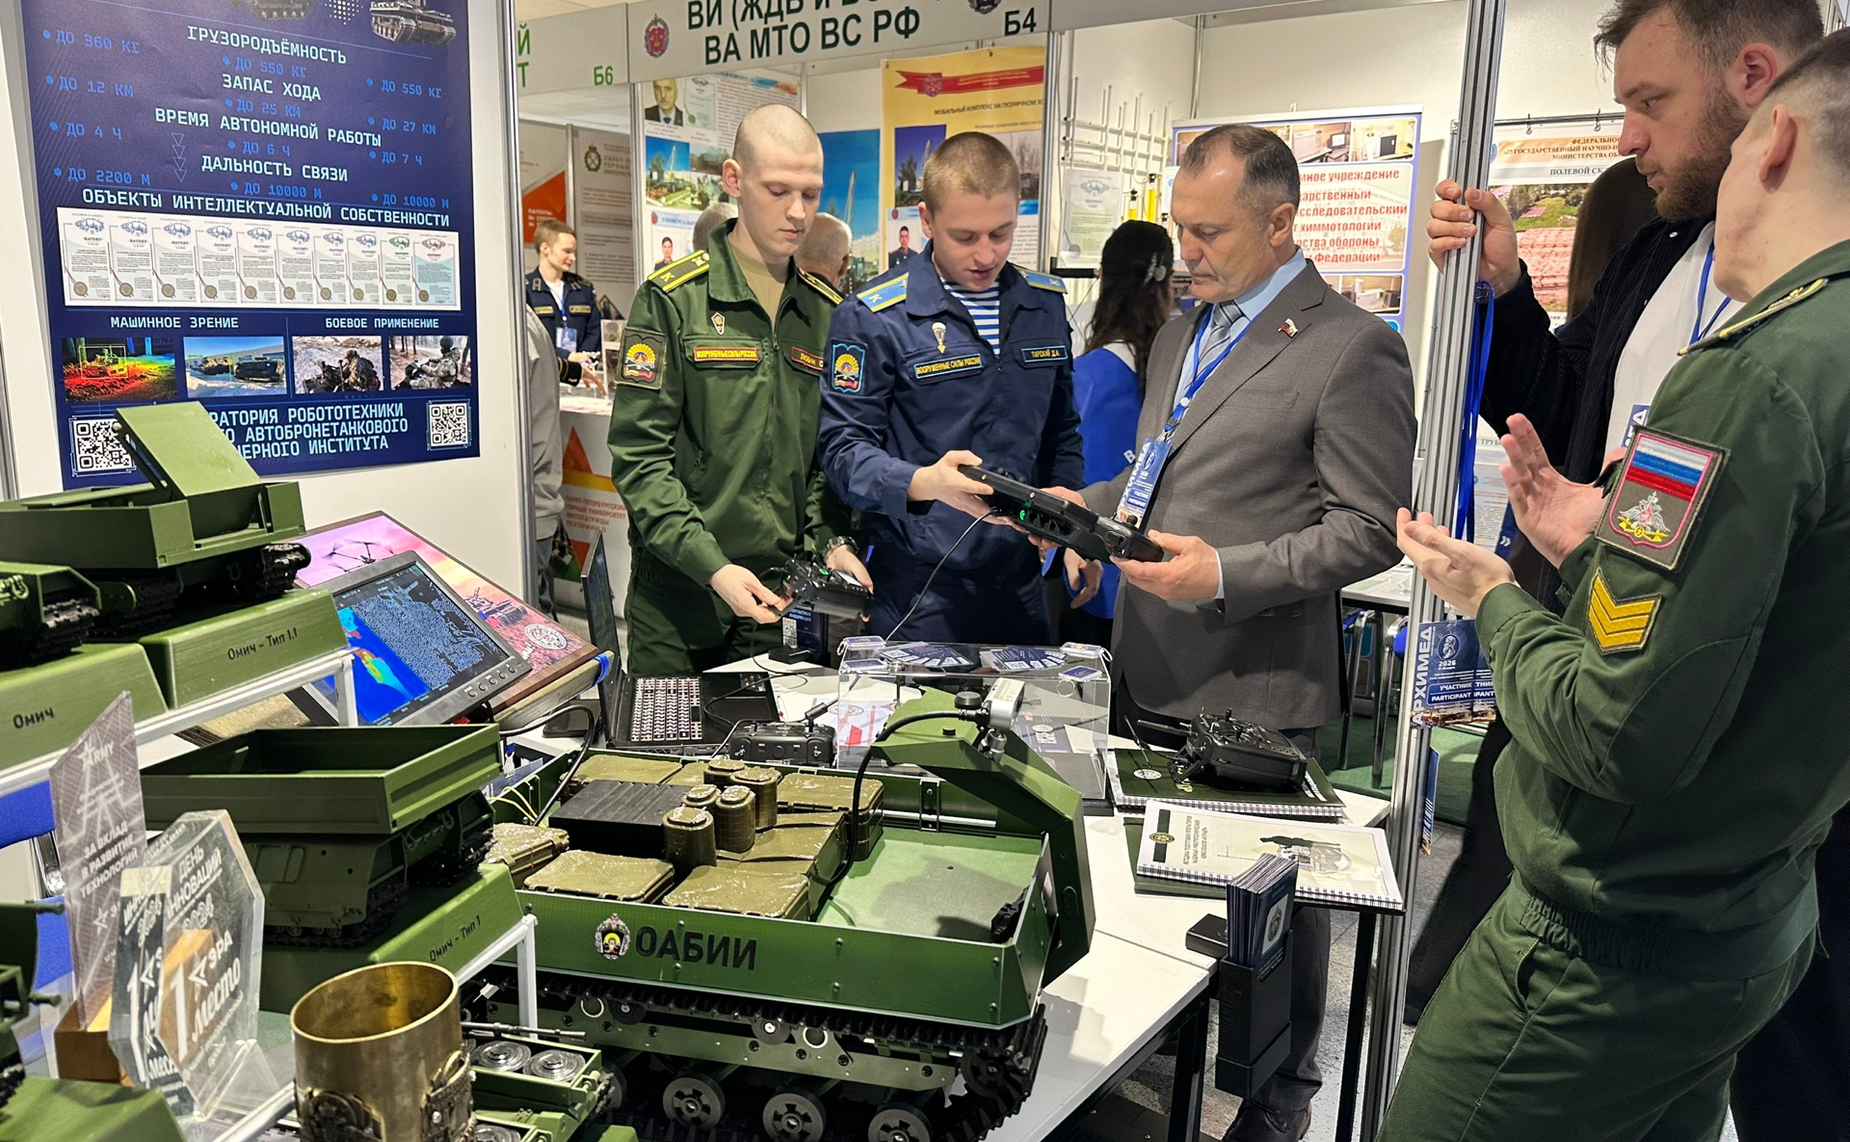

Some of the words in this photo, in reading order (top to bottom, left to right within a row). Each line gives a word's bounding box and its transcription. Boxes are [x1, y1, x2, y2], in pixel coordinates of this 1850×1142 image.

[688, 0, 722, 30] ВИ
[1004, 7, 1037, 36] Б4
[55, 29, 75, 45] ДО
[84, 33, 112, 50] 360
[121, 40, 140, 54] КГ
[187, 25, 347, 64] ГРУЗОРОДЪЁМНОСТЬ
[705, 32, 741, 65] ВА
[750, 21, 810, 60] МТО
[821, 13, 862, 50] ВС
[873, 6, 920, 43] РФ
[235, 57, 252, 71] ДО
[260, 60, 284, 74] 550
[291, 65, 307, 78] КГ
[593, 66, 613, 86] Б6
[59, 76, 78, 92] ДО
[87, 80, 105, 94] 12
[115, 83, 134, 97] КМ
[222, 73, 273, 94] ЗАПАС
[283, 82, 321, 102] ХОДА
[381, 79, 396, 93] ДО
[402, 82, 422, 96] 550
[428, 87, 442, 99] КГ
[237, 99, 254, 113] ДО
[262, 102, 277, 115] 25
[285, 105, 301, 118] КМ
[66, 122, 85, 138] ДО
[94, 127, 104, 138] 4
[155, 107, 210, 128] ВРЕМЯ
[220, 115, 319, 140] АВТОНОМНОЙ
[327, 128, 382, 147] РАБОТЫ
[382, 118, 396, 131] ДО
[403, 120, 416, 132] 27
[422, 124, 436, 135] КМ
[242, 141, 260, 155] ДО
[267, 143, 275, 155] 6
[381, 151, 396, 164] ДО
[402, 153, 409, 164] 7
[1514, 145, 1581, 154] ГОСУДАРСТВЕННЫЙ
[68, 167, 87, 182] ДО
[96, 170, 132, 183] 2200
[141, 173, 150, 185] М
[201, 155, 293, 177] ДАЛЬНОСТЬ
[301, 164, 348, 182] СВЯЗИ
[1328, 170, 1400, 183] учреждение
[1550, 167, 1589, 176] ПОЛЕВОЙ
[244, 182, 261, 195] ДО
[268, 184, 307, 198] 10000
[314, 188, 322, 199] М
[82, 188, 162, 208] ОБЪЕКТЫ
[173, 195, 332, 219] ИНТЕЛЛЕКТУАЛЬНОЙ
[340, 207, 450, 227] СОБСТВЕННОСТИ
[383, 193, 397, 206] ДО
[403, 196, 436, 208] 10000
[442, 199, 449, 209] М
[1300, 222, 1381, 233] химмотологии
[1329, 236, 1379, 249] обороны
[1314, 253, 1380, 264] Федерации
[110, 316, 181, 328] МАШИННОЕ
[190, 317, 239, 328] ЗРЕНИЕ
[325, 318, 367, 329] БОЕВОЕ
[374, 318, 439, 328] ПРИМЕНЕНИЕ
[288, 402, 404, 423] РОБОТОТЕХНИКИ
[246, 418, 408, 443] АВТОБРОНЕТАНКОВОГО
[309, 435, 389, 455] ИНСТИТУТА
[227, 643, 257, 661] Омич
[266, 633, 287, 650] Тип
[287, 626, 298, 642] 1.1
[1431, 692, 1472, 702] PARTICIPANT
[1439, 682, 1473, 692] УЧАСТНИК
[13, 707, 55, 729] Омич
[83, 842, 97, 860] ЗА
[89, 834, 133, 874] РАЗВИТИЕ
[80, 847, 138, 898] ТЕХНОЛОГИЙ
[179, 844, 204, 884] ДЕНЬ
[208, 930, 233, 969] ЭРА
[429, 939, 453, 962] Омич
[460, 922, 476, 940] Тип
[635, 925, 757, 970] ОАБИИ
[170, 962, 188, 1063] 1
